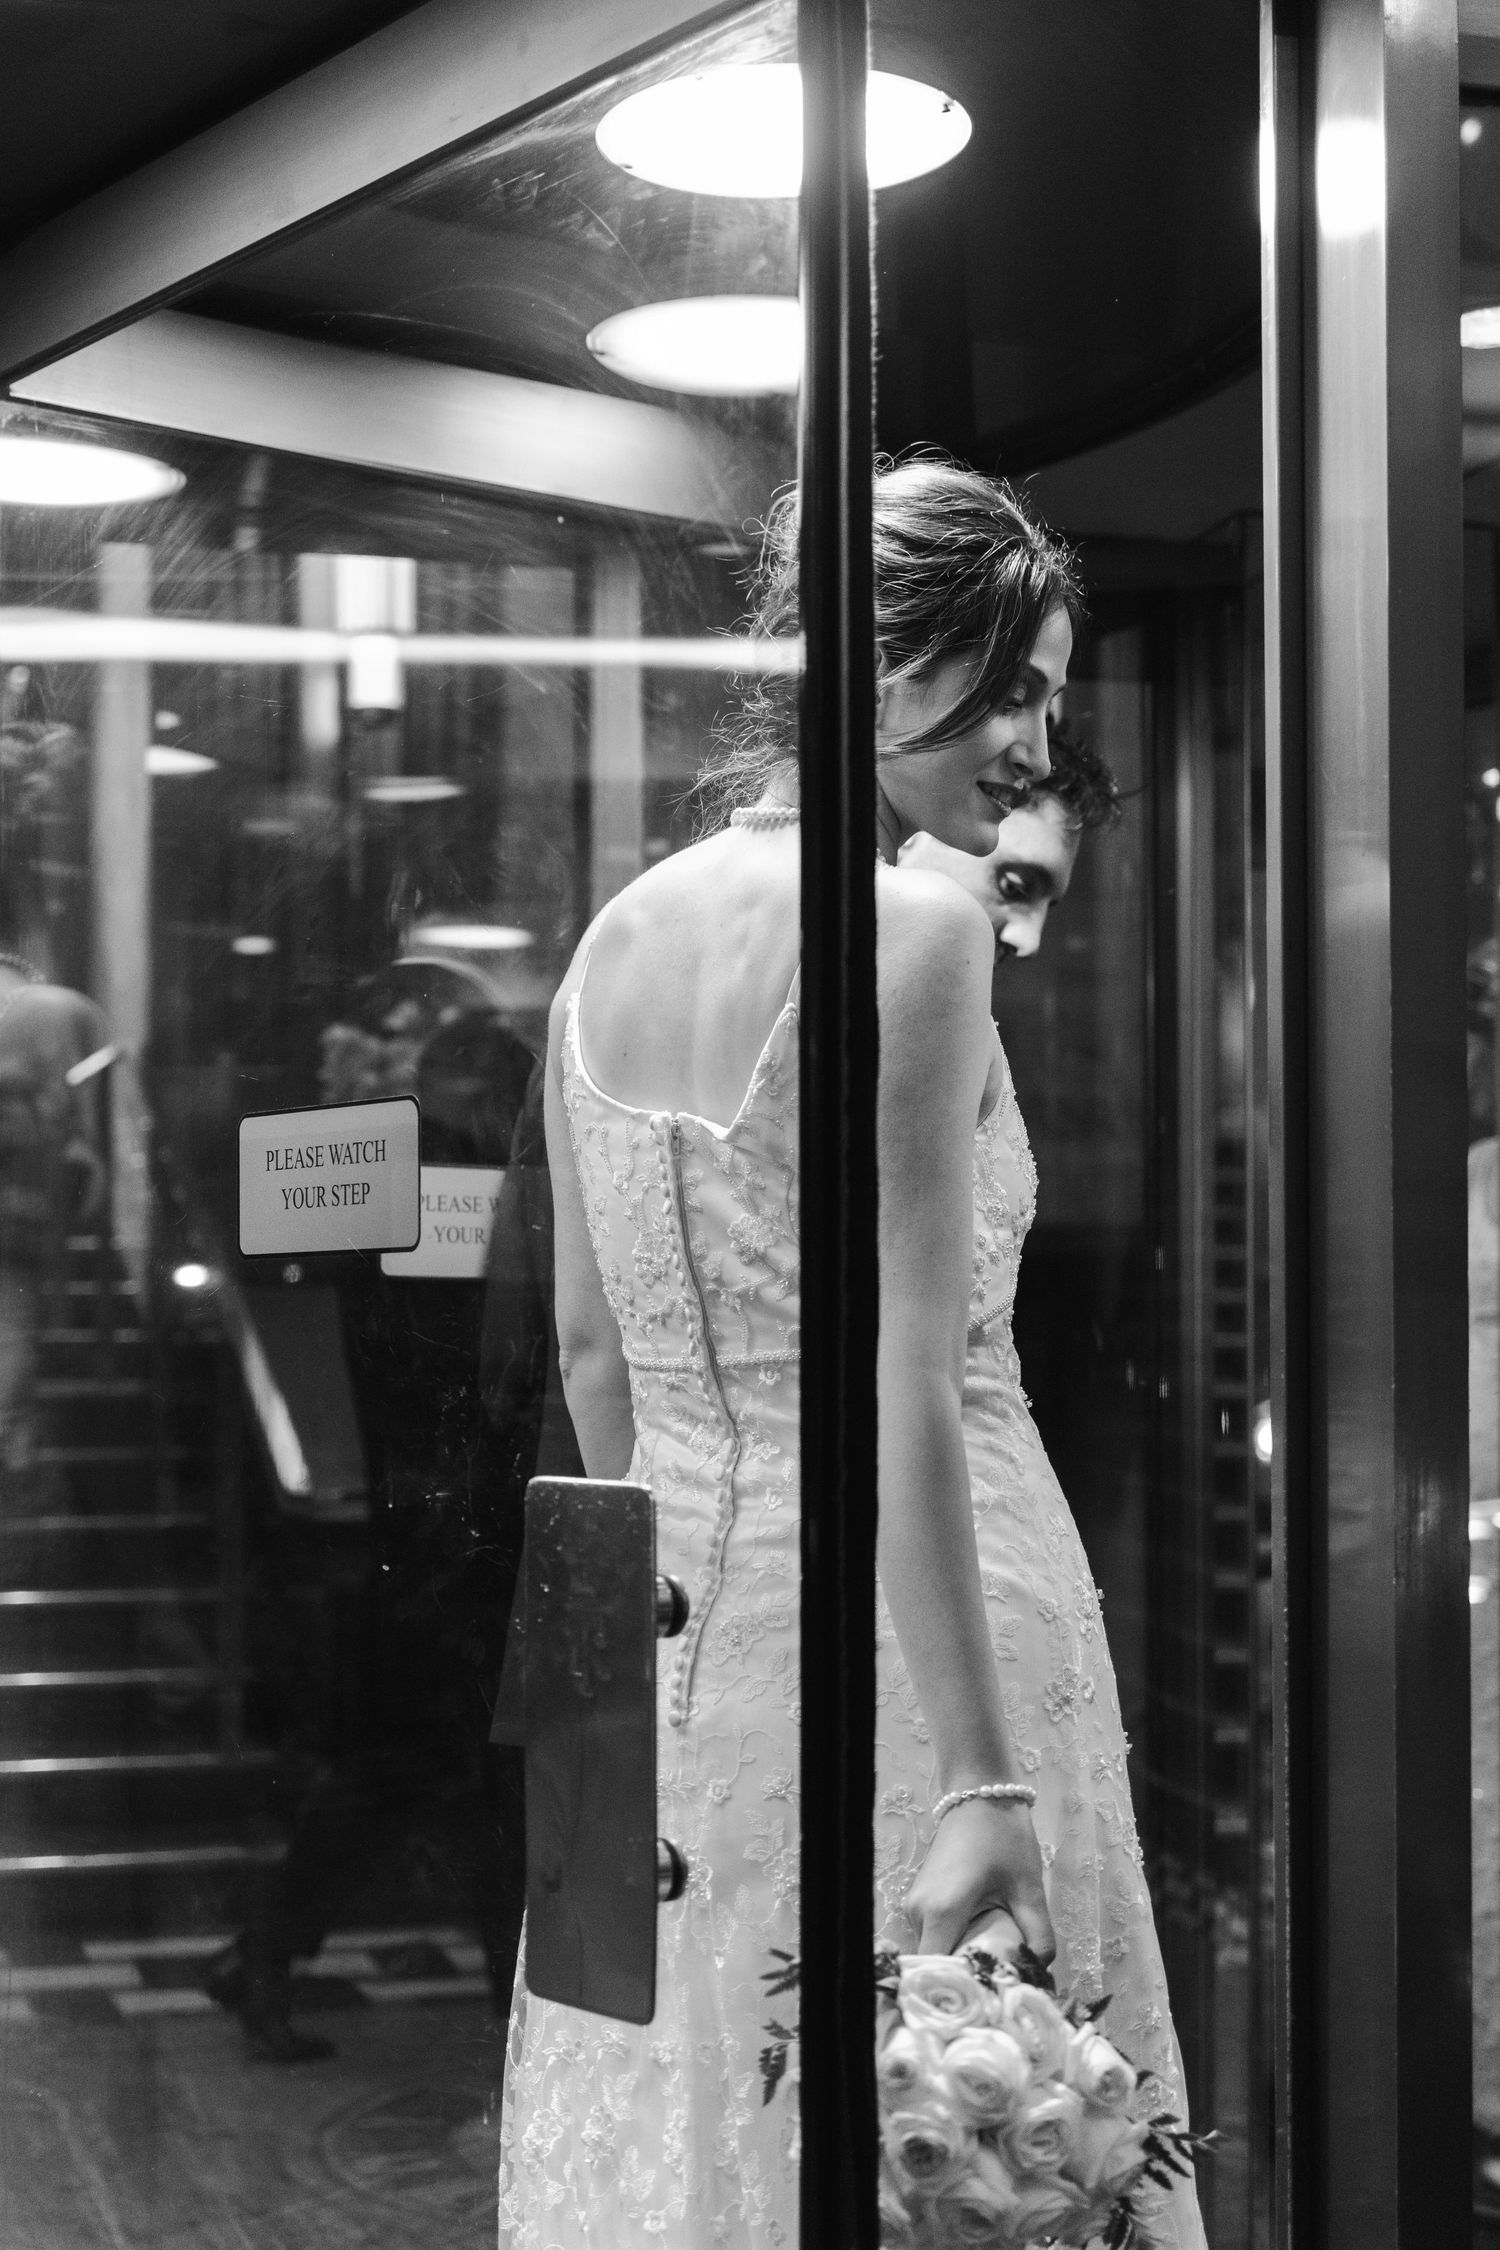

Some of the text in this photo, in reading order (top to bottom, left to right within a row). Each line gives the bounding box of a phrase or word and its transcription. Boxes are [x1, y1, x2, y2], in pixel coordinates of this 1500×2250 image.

[266, 1139, 386, 1171] PLEASE WATCH
[281, 1182, 371, 1210] YOUR STEP
[434, 1225, 487, 1245] YOUR
